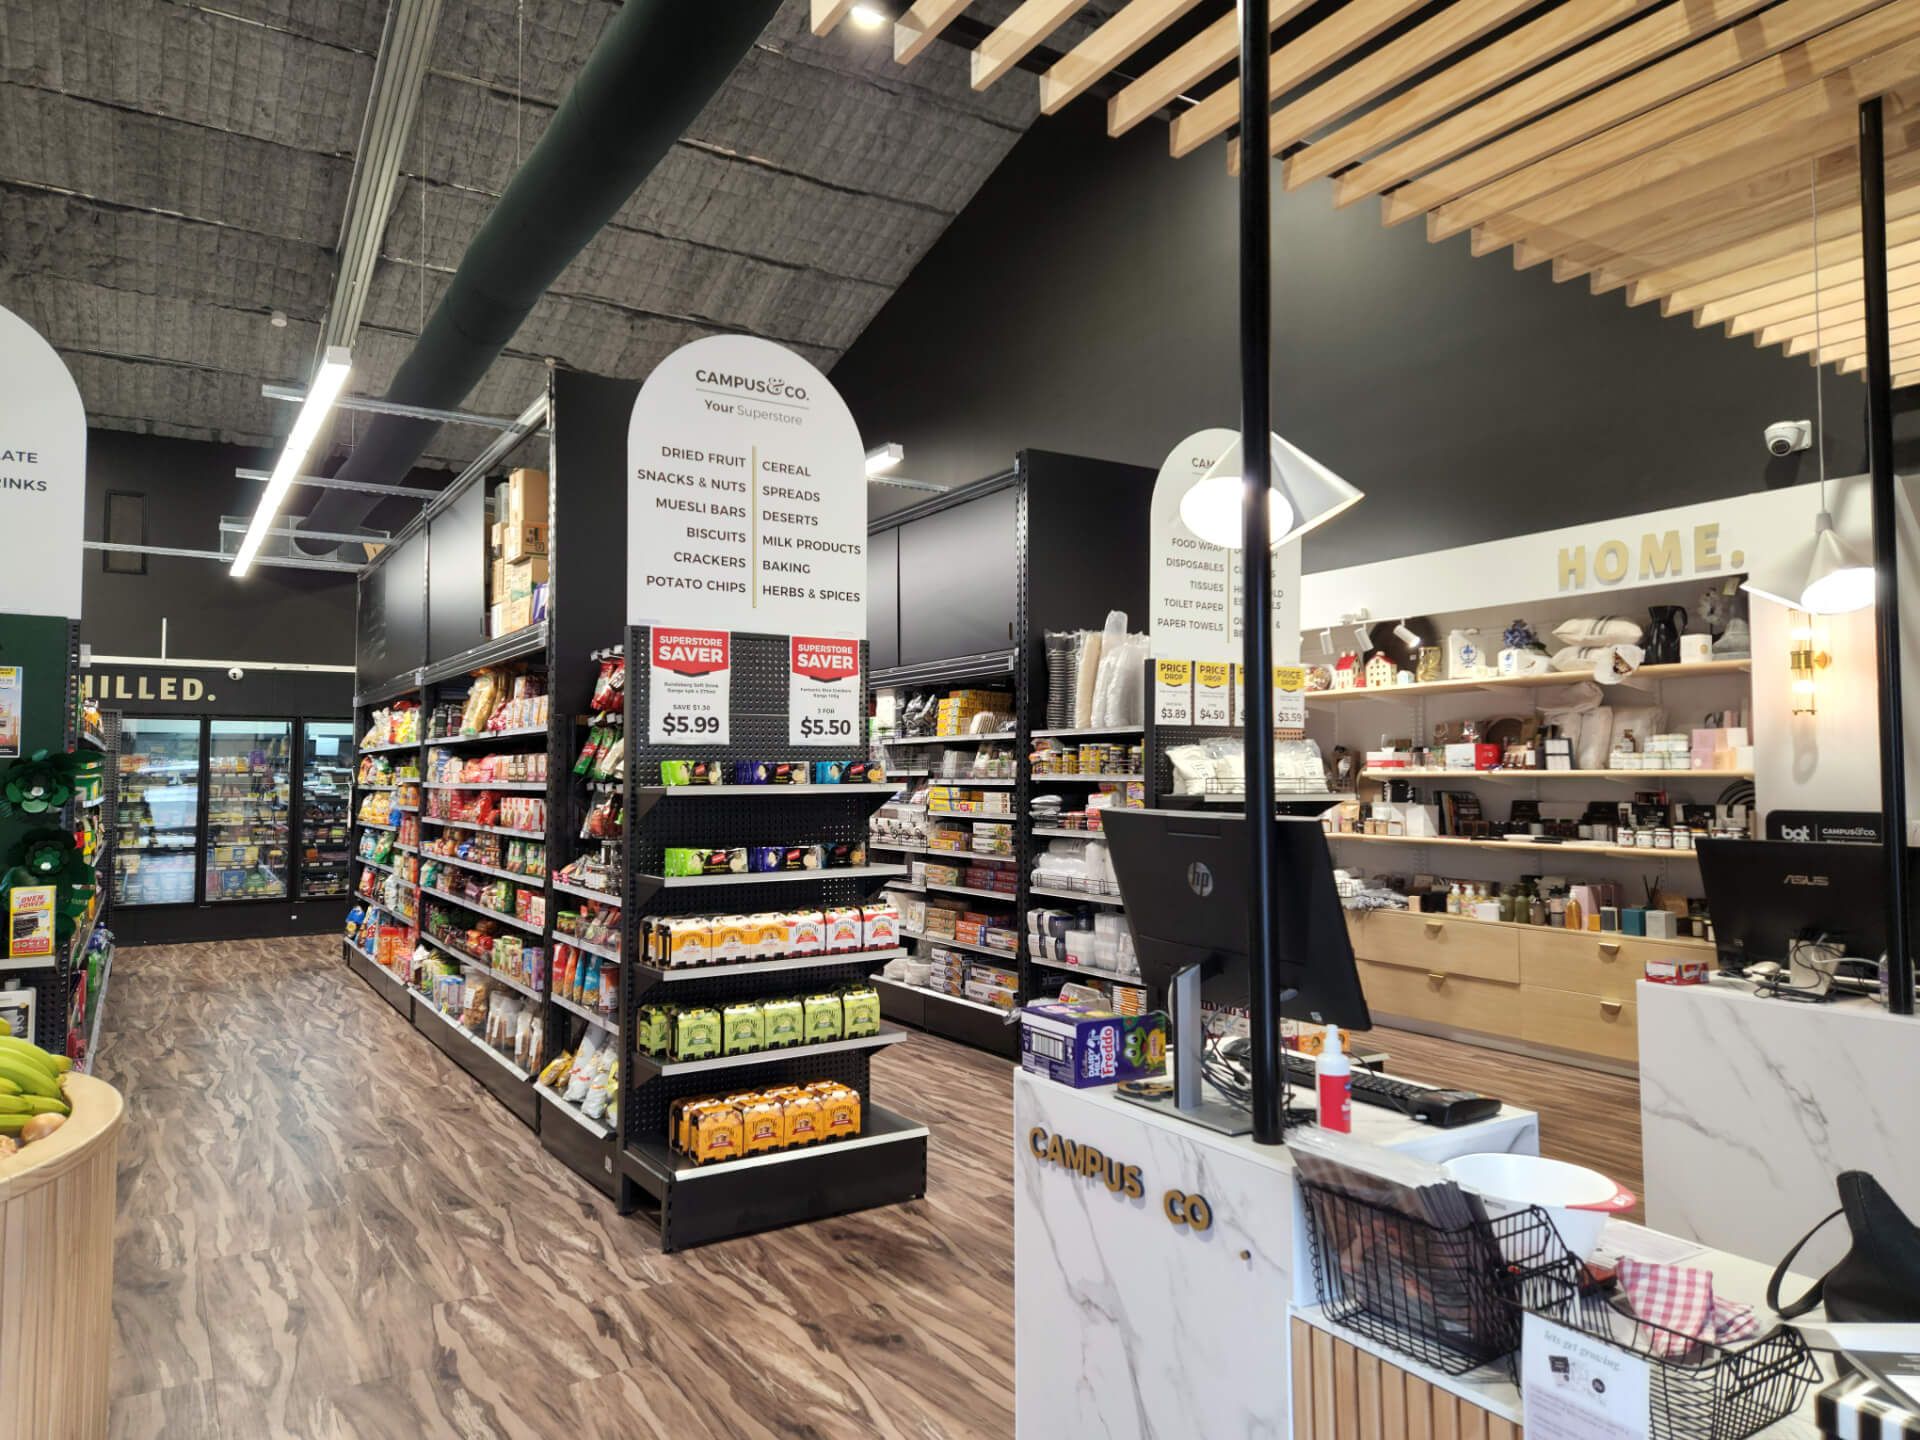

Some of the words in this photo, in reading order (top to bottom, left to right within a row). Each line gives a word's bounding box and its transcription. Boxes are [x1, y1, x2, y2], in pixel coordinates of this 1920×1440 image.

[696, 369, 809, 400] CAMPUS&CO.
[705, 400, 734, 414] Your
[737, 404, 802, 426] Superstore
[0, 450, 38, 464] ATE
[662, 446, 704, 462] DRIED
[708, 452, 746, 468] FRUIT
[1192, 458, 1216, 468] CAM
[762, 460, 812, 477] CEREAL
[637, 469, 694, 486] SNACKS
[698, 477, 707, 488] &
[711, 478, 746, 493] NUTS
[762, 485, 820, 502] SPREADS
[656, 497, 706, 514] MUESLI
[710, 503, 746, 518] BARS
[762, 510, 818, 526] DESERTS
[687, 527, 746, 542] BISCUITS
[762, 535, 793, 548] MILK
[796, 539, 861, 555] PRODUCTS
[1172, 538, 1196, 549] FOOD
[673, 551, 746, 568] CRACKERS
[1166, 558, 1224, 572] DISPOSABLES
[1558, 523, 1744, 591] HOME.
[762, 560, 810, 574] BAKING
[646, 575, 701, 589] POTATO
[707, 580, 746, 593] CHIPS
[1190, 580, 1224, 592] TISSUES
[762, 585, 804, 598] HERBS
[808, 589, 815, 599] &
[819, 589, 860, 603] SPICES
[1164, 598, 1193, 609] TOILET
[1196, 602, 1224, 611] PAPER
[1157, 618, 1186, 628] PAPER
[1189, 621, 1224, 632] TOWELS
[659, 635, 723, 647] SUPERSTORE
[798, 643, 853, 655] SUPERSTORE
[658, 646, 723, 663] SAVER
[797, 654, 853, 670] SAVER
[1160, 663, 1187, 673] PRICE
[1200, 665, 1225, 675] PRICE
[1277, 670, 1300, 679] PRICE
[84, 674, 216, 701] ILLED.
[1161, 708, 1186, 719] $3.89
[1200, 709, 1224, 720] $4.50
[662, 713, 719, 736] $5.99
[800, 716, 851, 738] $5.50
[1783, 875, 1829, 886] ASUS
[1102, 1028, 1113, 1075] Freddo
[1029, 1127, 1145, 1199] CAMPUS
[1163, 1189, 1213, 1232] CO
